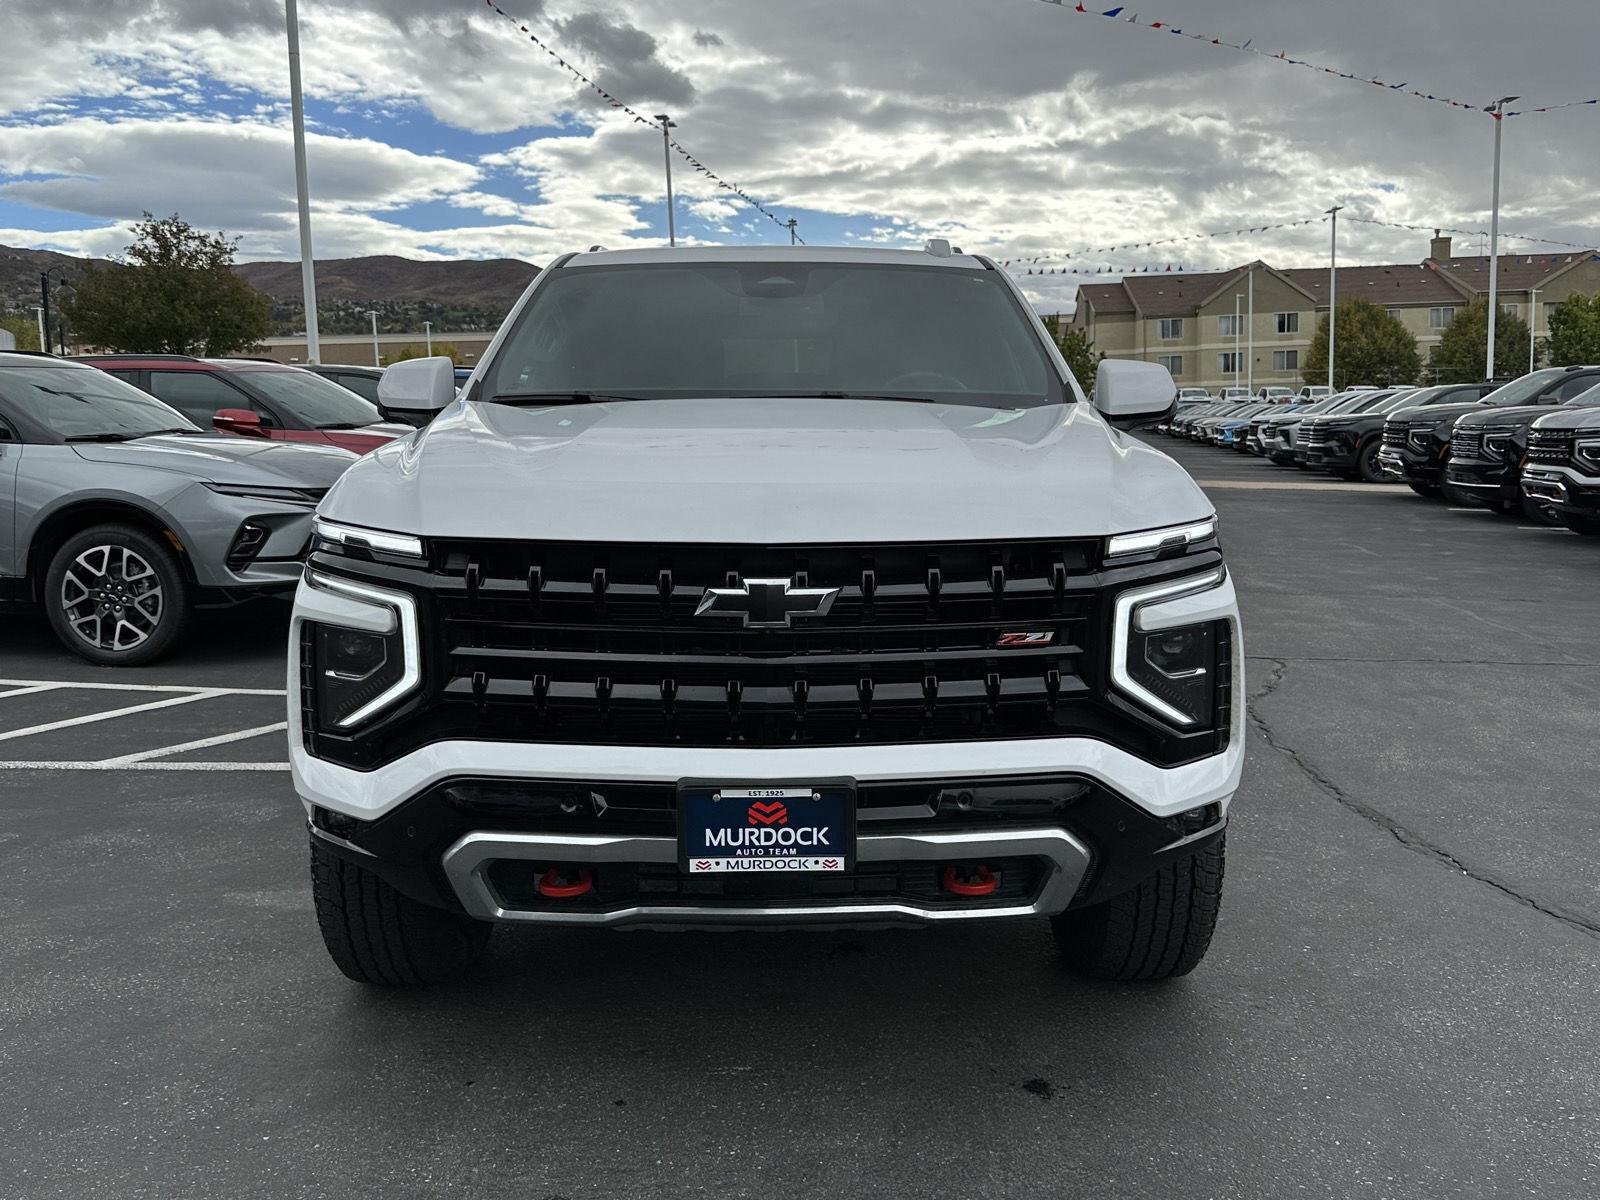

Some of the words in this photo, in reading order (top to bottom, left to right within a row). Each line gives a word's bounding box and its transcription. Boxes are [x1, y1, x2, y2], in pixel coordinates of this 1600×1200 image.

[996, 631, 1055, 646] Z71
[705, 826, 830, 847] MURDOCK
[735, 848, 764, 856] AUTO
[726, 858, 810, 870] MURDOCK
